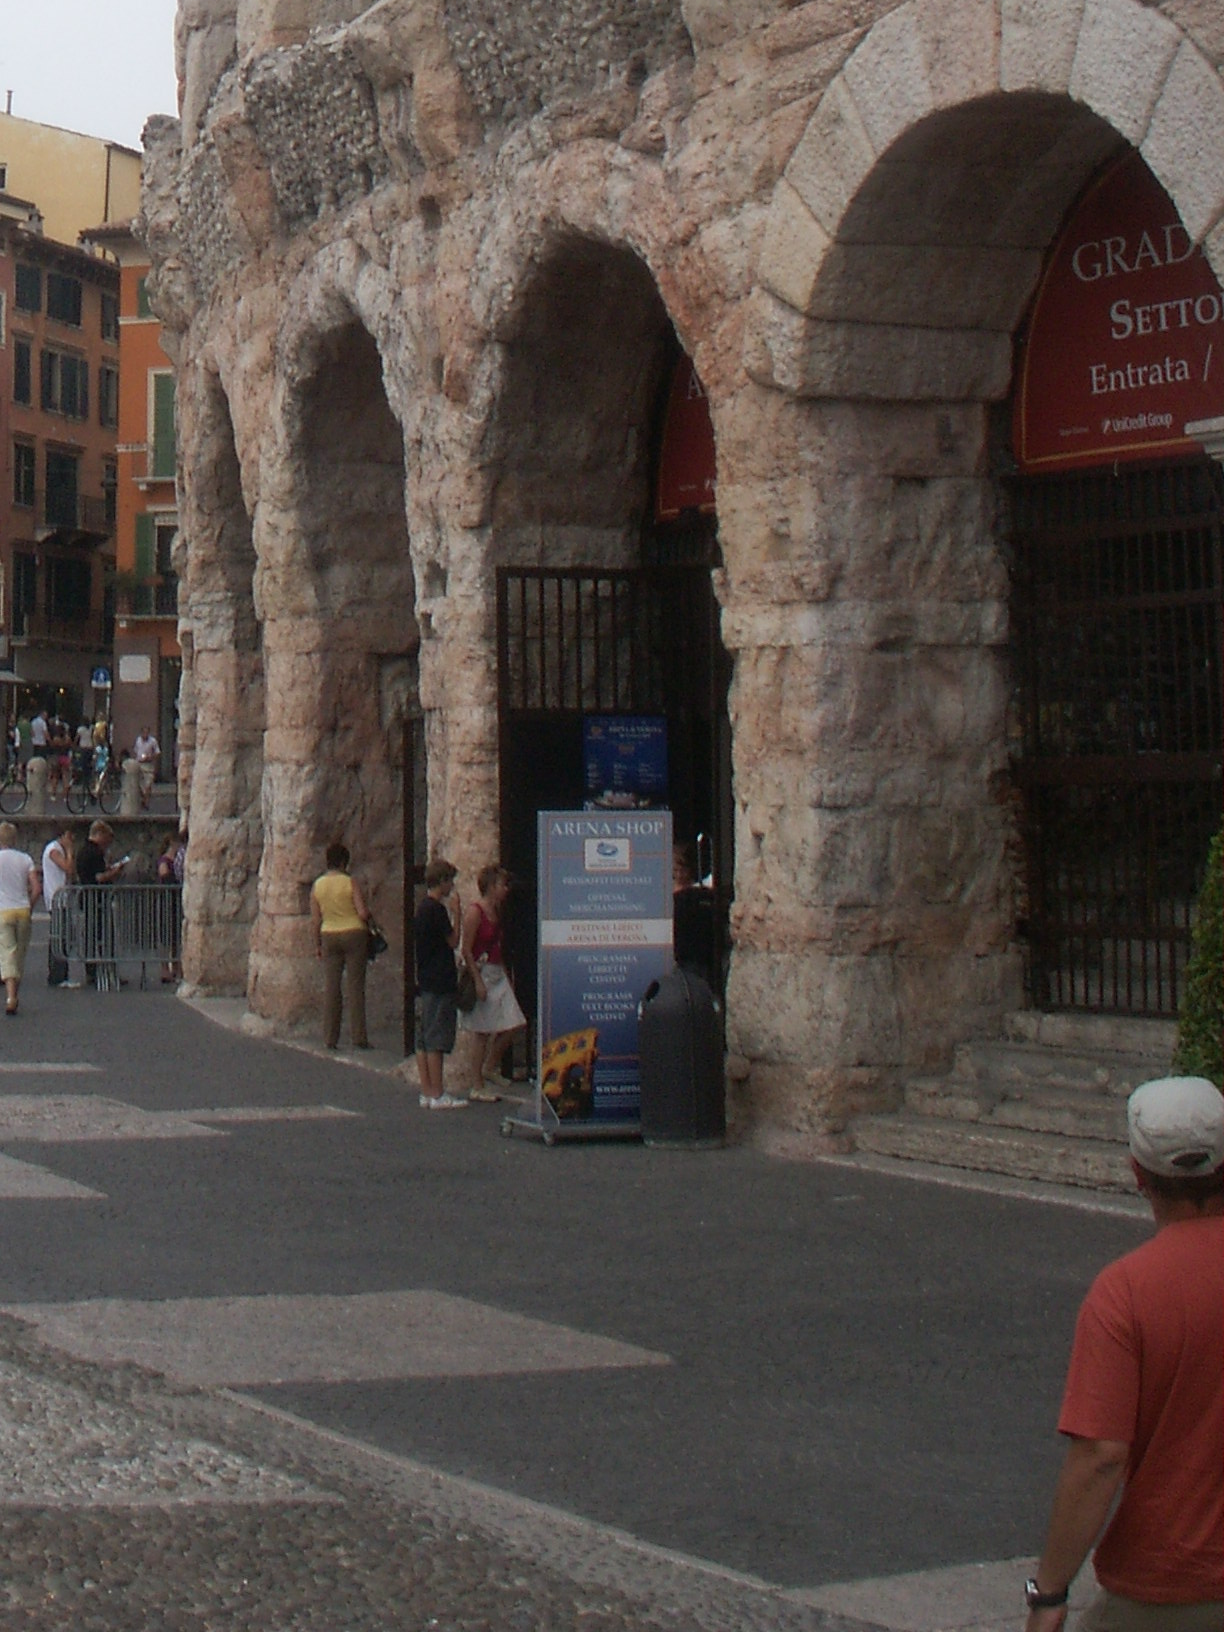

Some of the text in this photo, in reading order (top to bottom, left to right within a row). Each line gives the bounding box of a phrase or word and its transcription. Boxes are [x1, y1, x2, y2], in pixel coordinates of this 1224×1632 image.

[1072, 223, 1206, 282] GRAD
[1089, 356, 1191, 395] Entrata
[552, 820, 664, 837] ARENA SHOP
